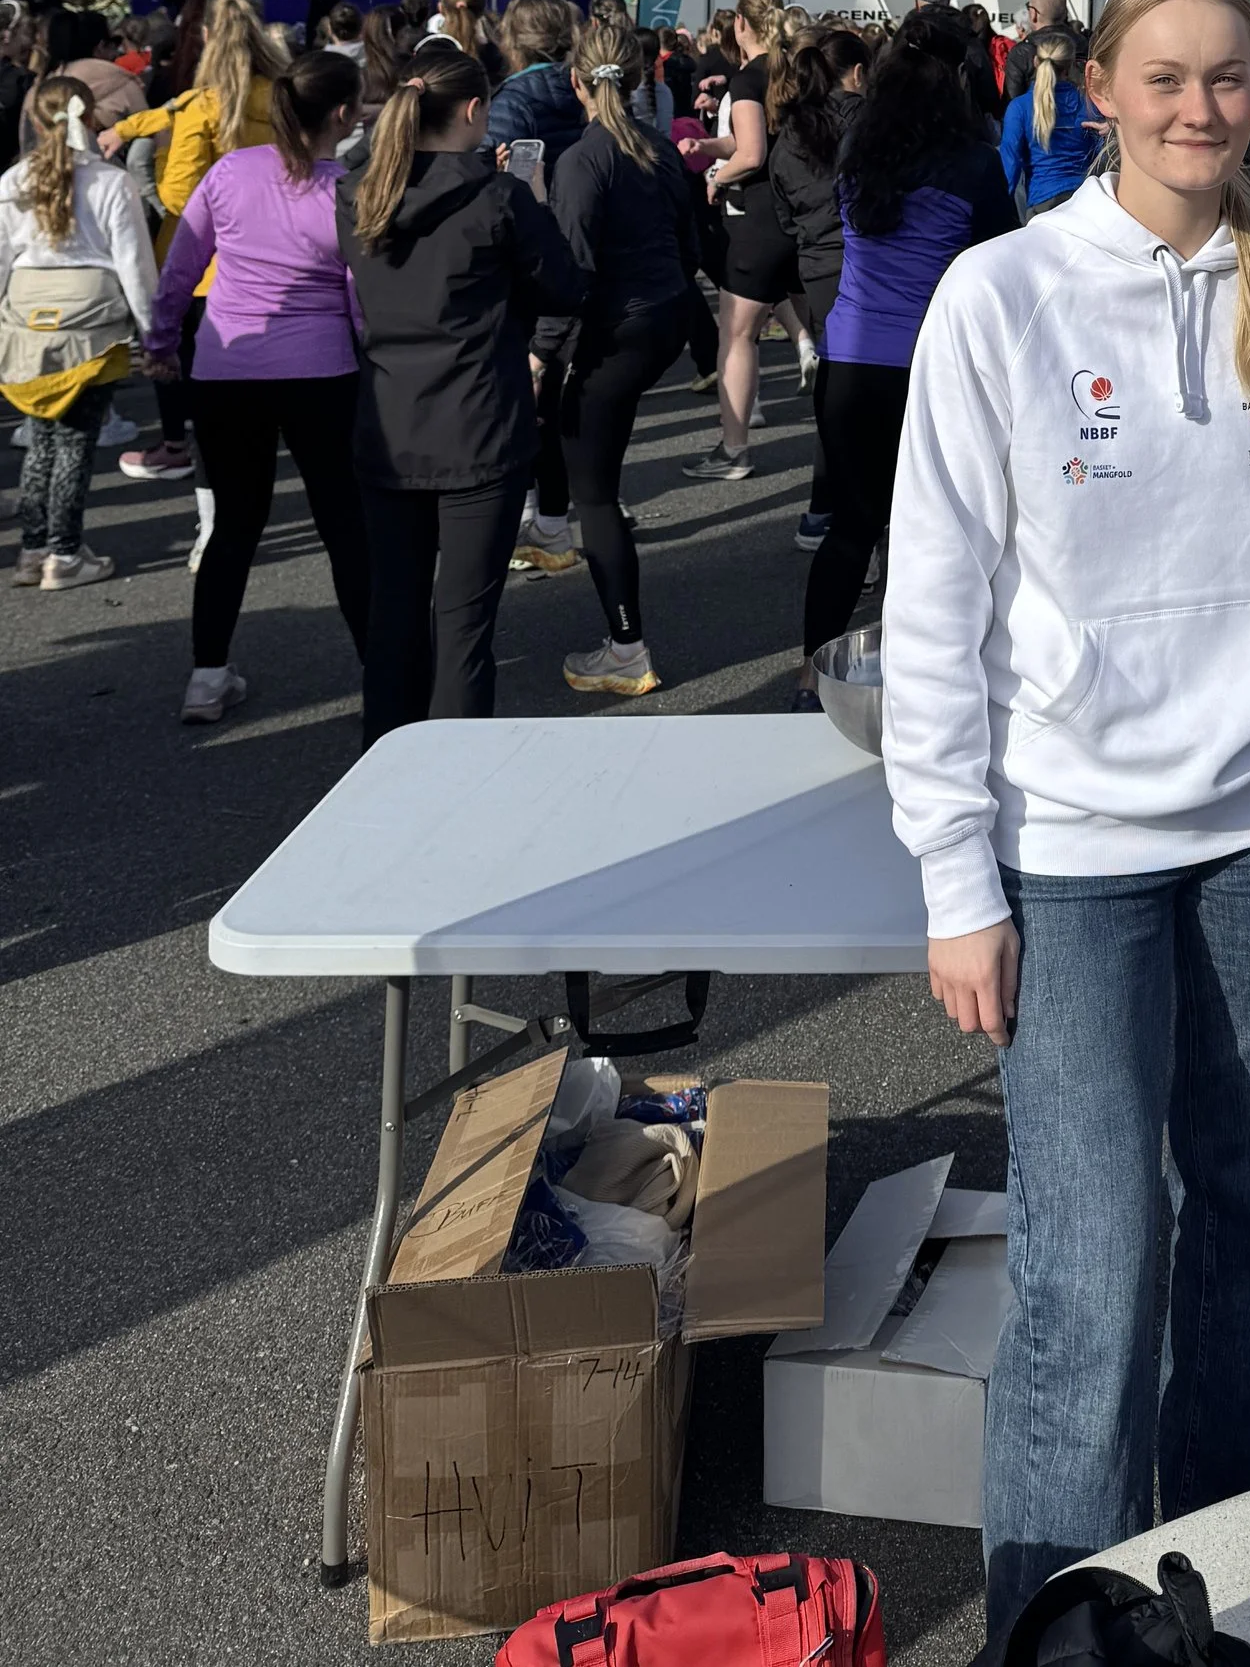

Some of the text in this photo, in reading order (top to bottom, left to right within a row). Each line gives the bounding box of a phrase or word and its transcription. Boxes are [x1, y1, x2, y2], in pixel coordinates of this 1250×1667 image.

[1080, 427, 1119, 440] NBBF
[1092, 470, 1133, 479] MANGFOLD
[579, 1357, 645, 1392] 7-14
